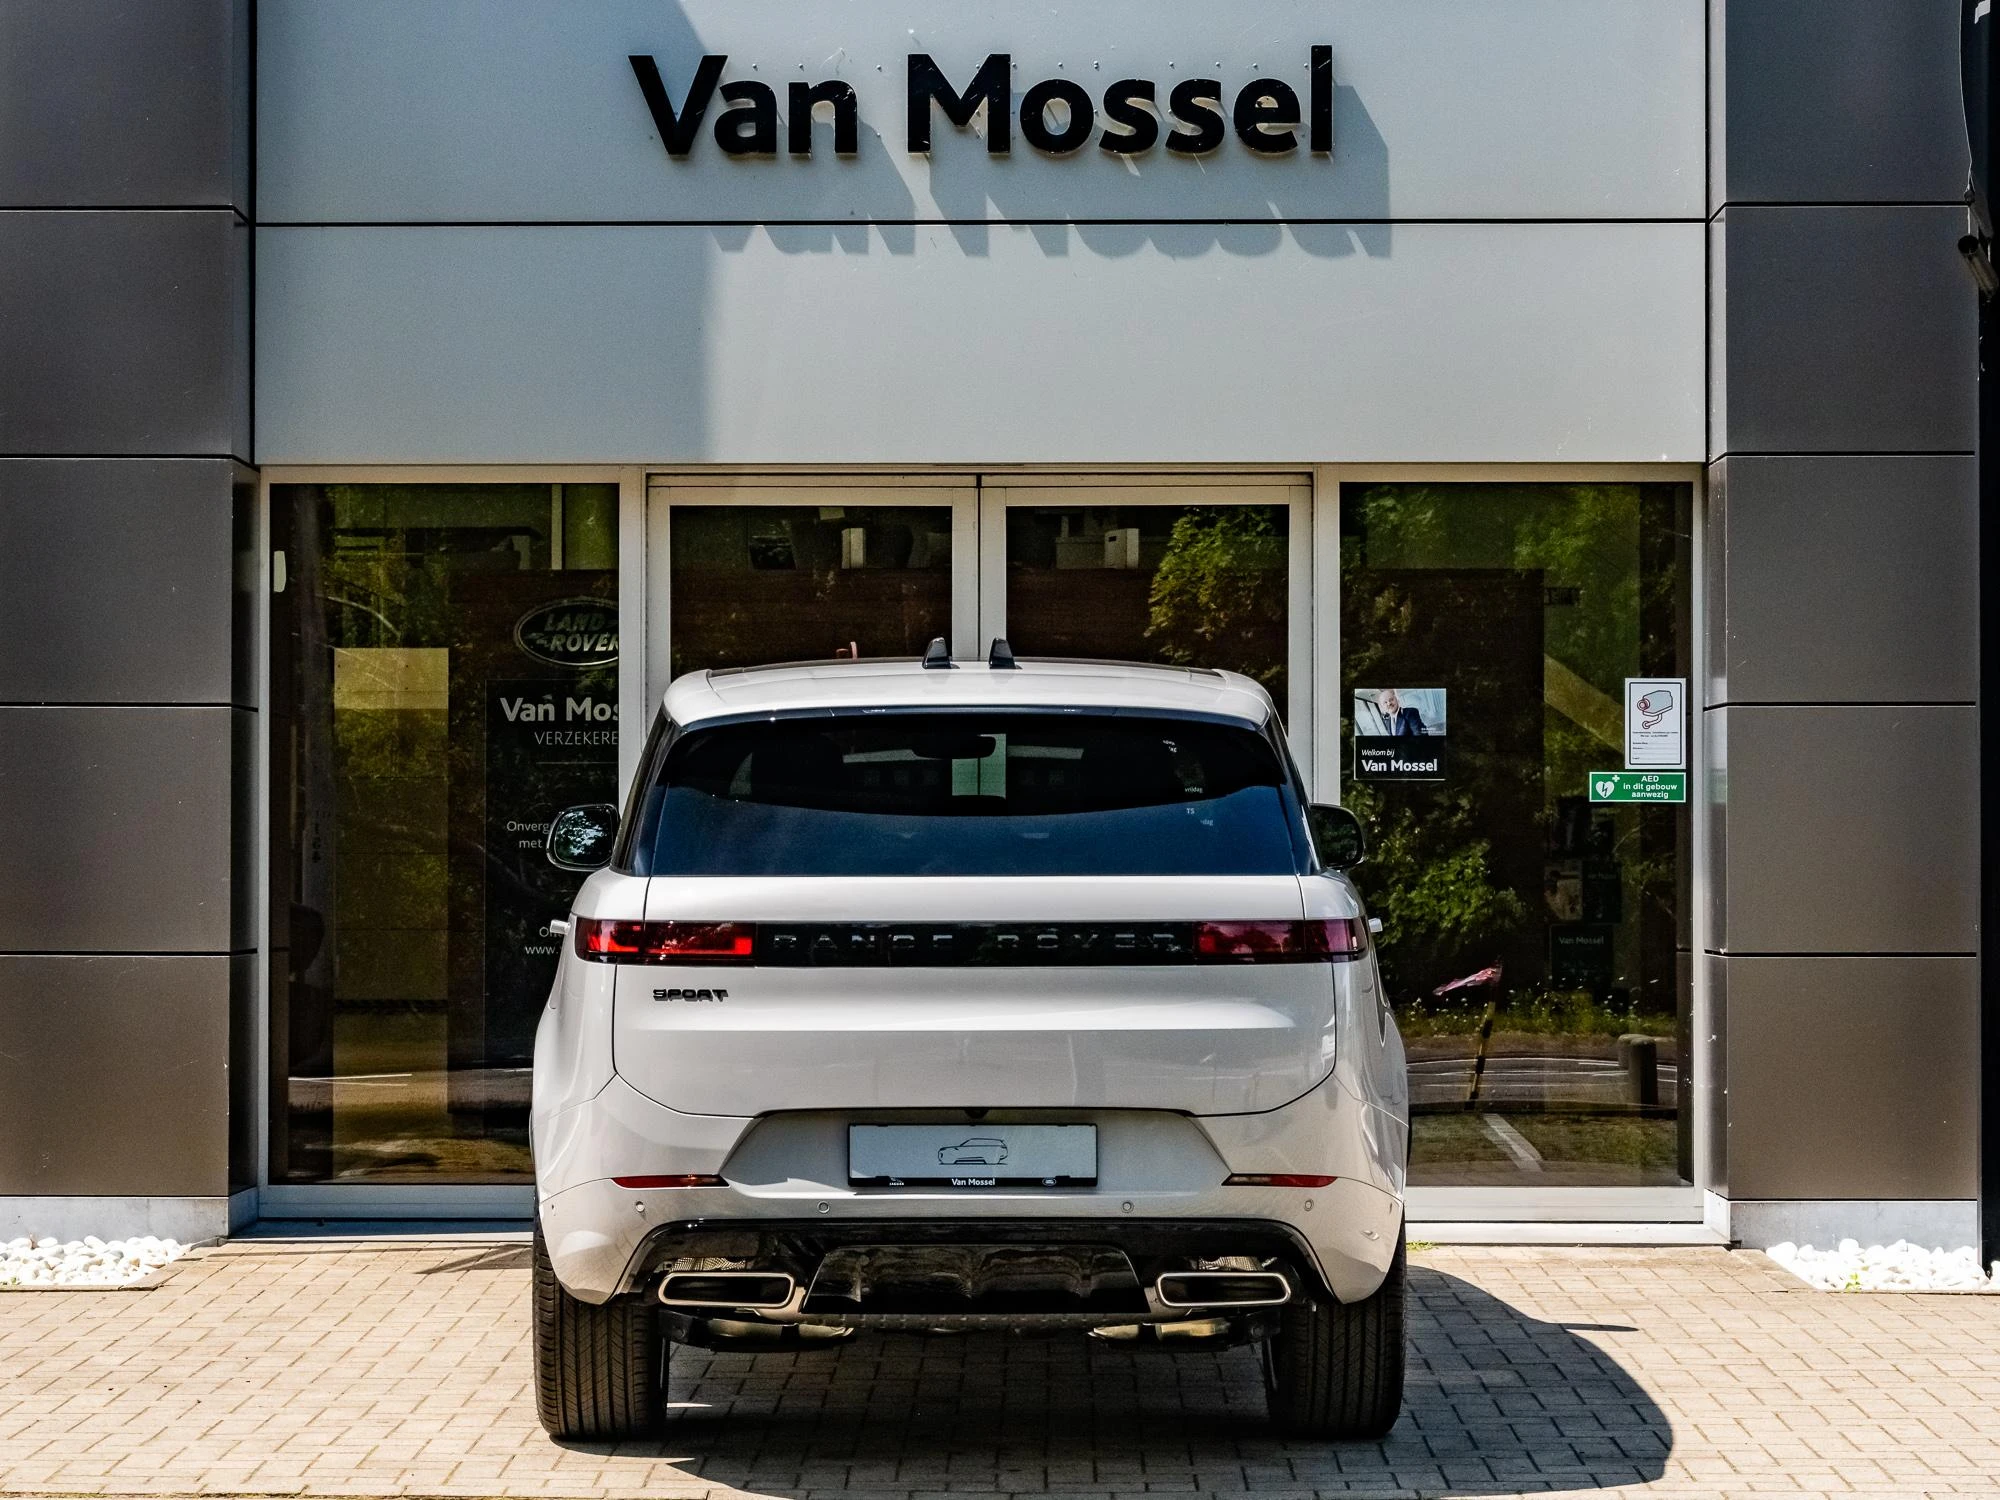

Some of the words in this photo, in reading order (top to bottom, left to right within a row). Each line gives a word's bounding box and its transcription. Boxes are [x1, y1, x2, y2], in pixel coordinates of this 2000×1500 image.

[628, 54, 858, 156] Van
[907, 44, 1333, 155] Mossel
[545, 613, 605, 632] LAND
[500, 697, 555, 722] Van
[1361, 749, 1386, 757] Welkom
[1386, 749, 1395, 758] bij
[1361, 760, 1387, 772] Van
[1391, 758, 1438, 772] Mossel
[1641, 775, 1660, 783] AED
[1623, 782, 1631, 790] in
[1632, 782, 1644, 790] dit
[1645, 782, 1678, 792] gebouw
[1631, 791, 1669, 800] aanwezig
[518, 839, 543, 849] met
[652, 988, 729, 1002] SPORT
[951, 1178, 967, 1186] Van
[968, 1178, 996, 1186] Mossel
